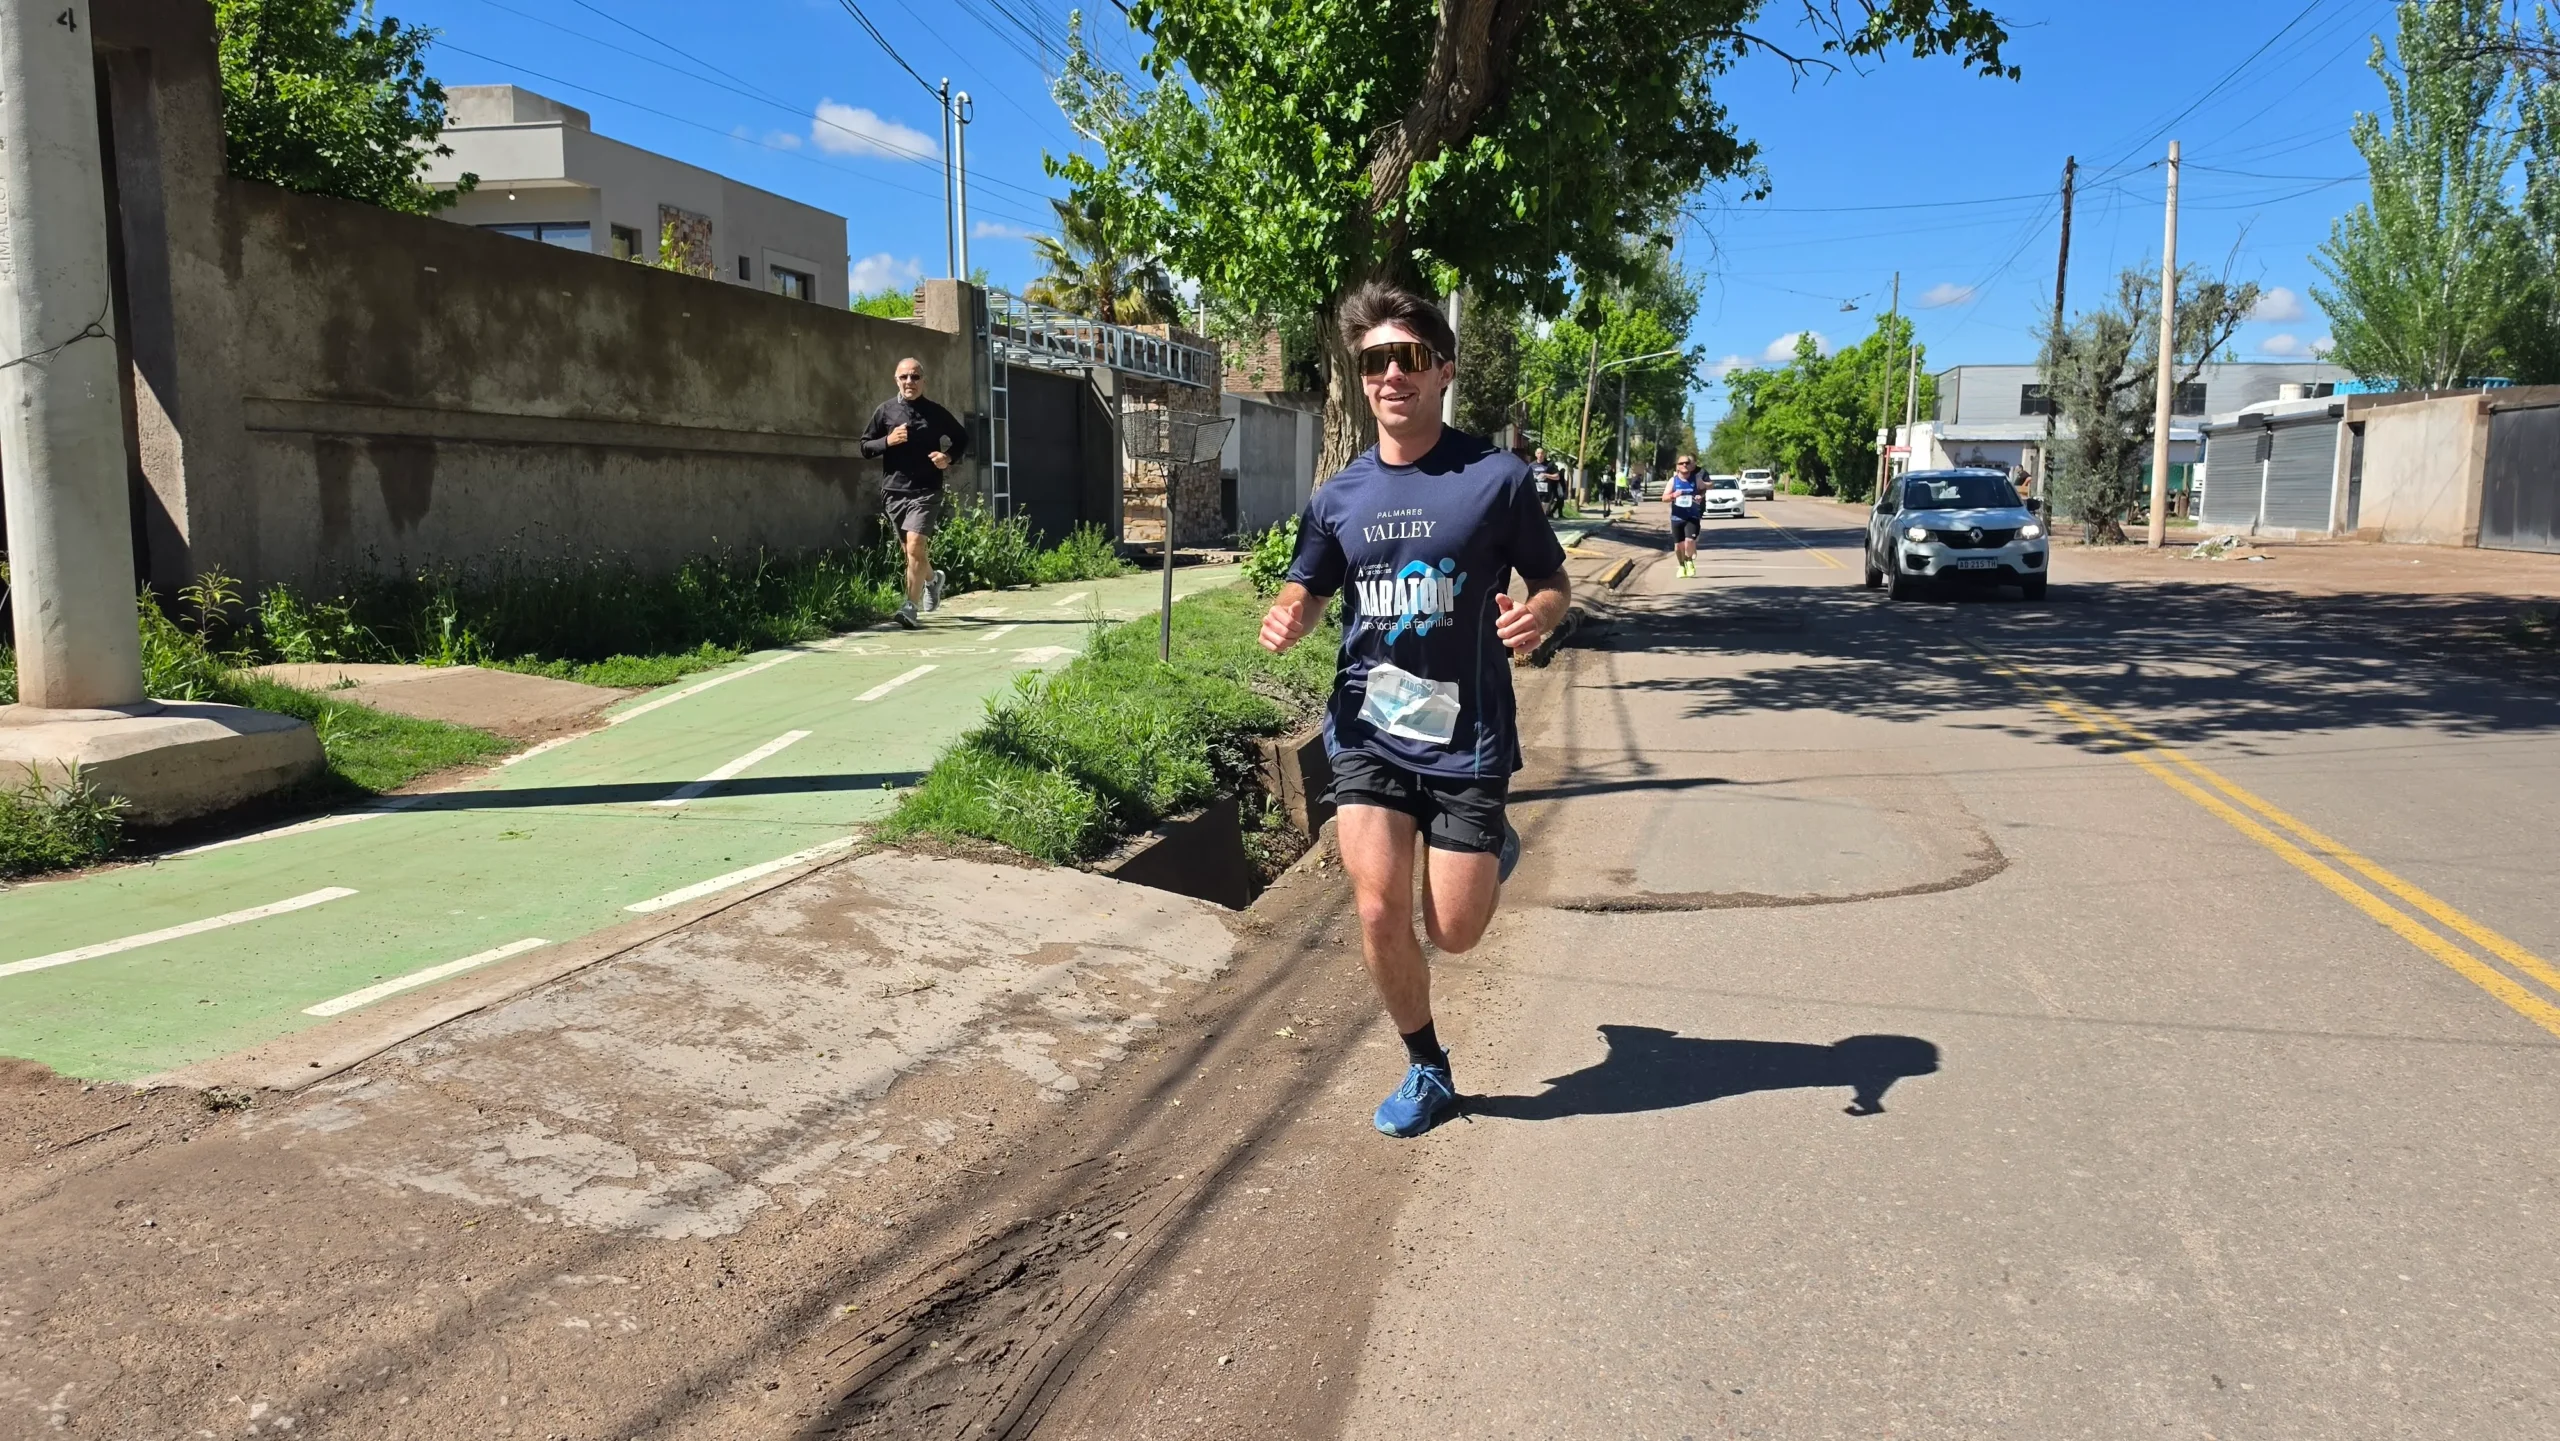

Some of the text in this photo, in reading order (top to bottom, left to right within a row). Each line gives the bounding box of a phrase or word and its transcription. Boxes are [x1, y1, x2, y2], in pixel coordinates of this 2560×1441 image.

[57, 7, 77, 33] 4
[1376, 508, 1423, 519] PALMARES
[1362, 521, 1437, 543] VALLEY
[1401, 618, 1412, 630] la
[1413, 616, 1453, 629] familia
